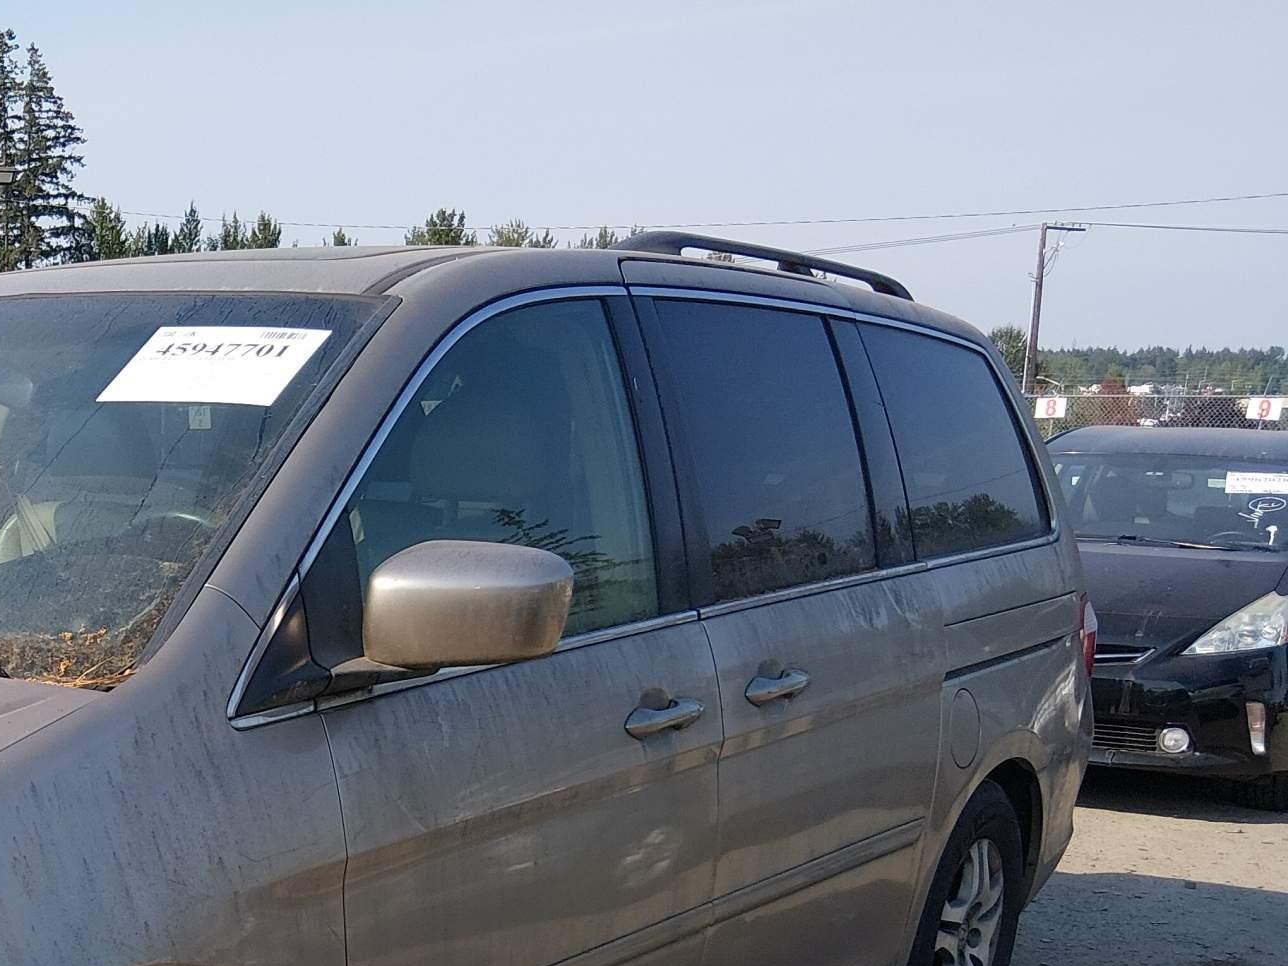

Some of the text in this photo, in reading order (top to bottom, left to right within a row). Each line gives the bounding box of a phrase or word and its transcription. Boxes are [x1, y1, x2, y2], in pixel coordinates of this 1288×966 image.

[156, 343, 289, 357] 45947701
[1045, 399, 1057, 417] 8
[1258, 399, 1272, 418] 9
